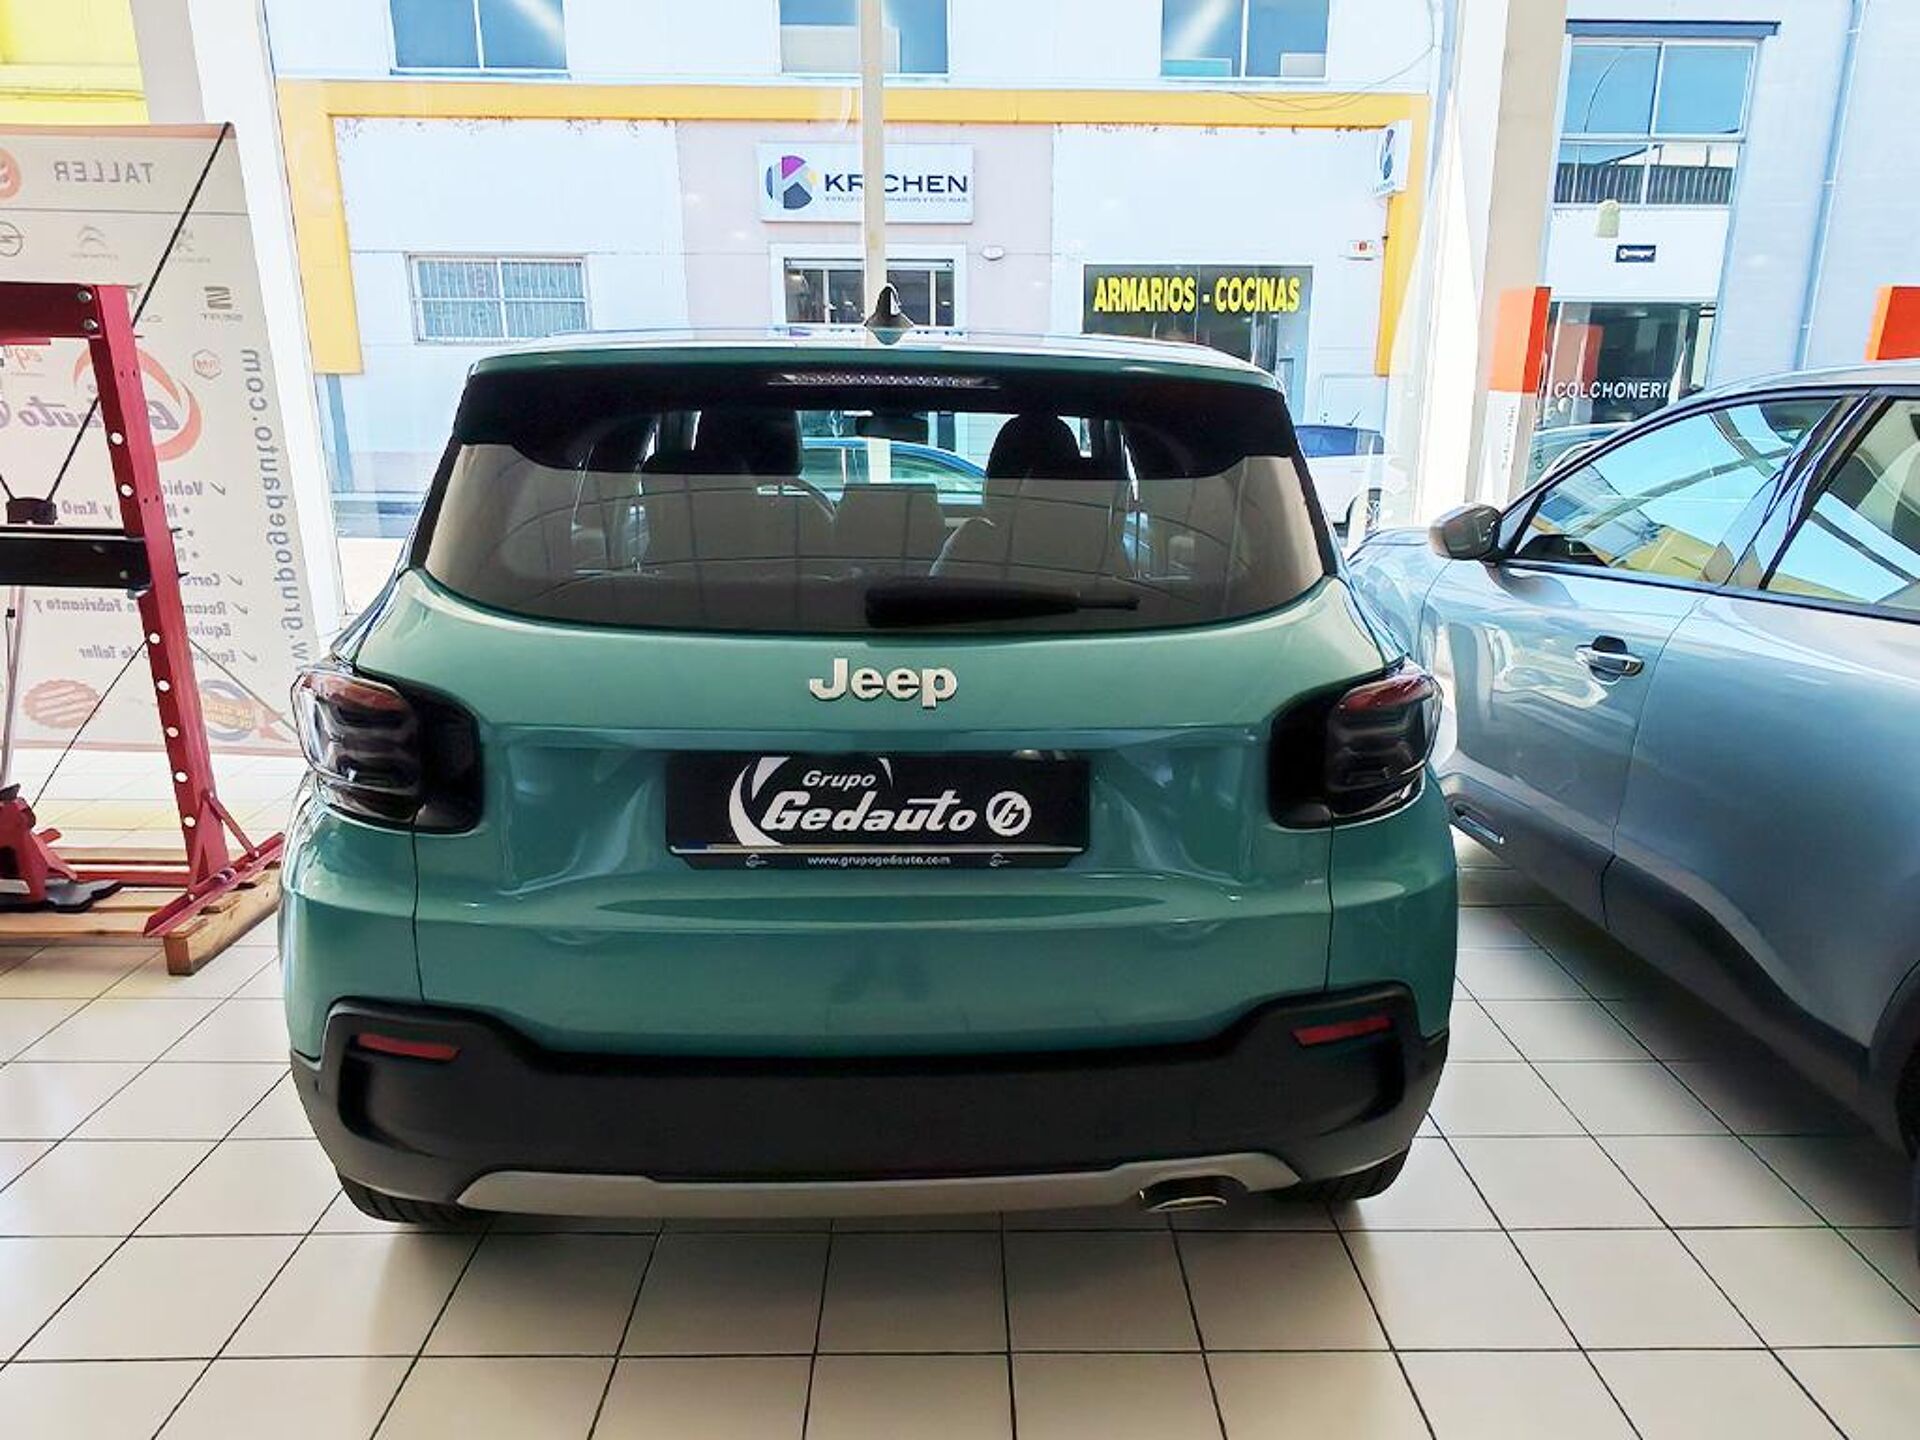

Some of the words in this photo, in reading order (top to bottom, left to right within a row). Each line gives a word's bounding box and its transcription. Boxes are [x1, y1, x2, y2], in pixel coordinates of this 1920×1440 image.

[824, 173, 968, 193] KRCHEN
[1093, 276, 1196, 313] ARMARIOS
[1215, 276, 1300, 313] COCINAS
[1554, 381, 1669, 399] COLCHONERI
[809, 658, 958, 708] Jeep
[802, 769, 876, 791] Grupo
[760, 790, 978, 832] Gedauto
[807, 856, 950, 867] www.grupogedauto.com
